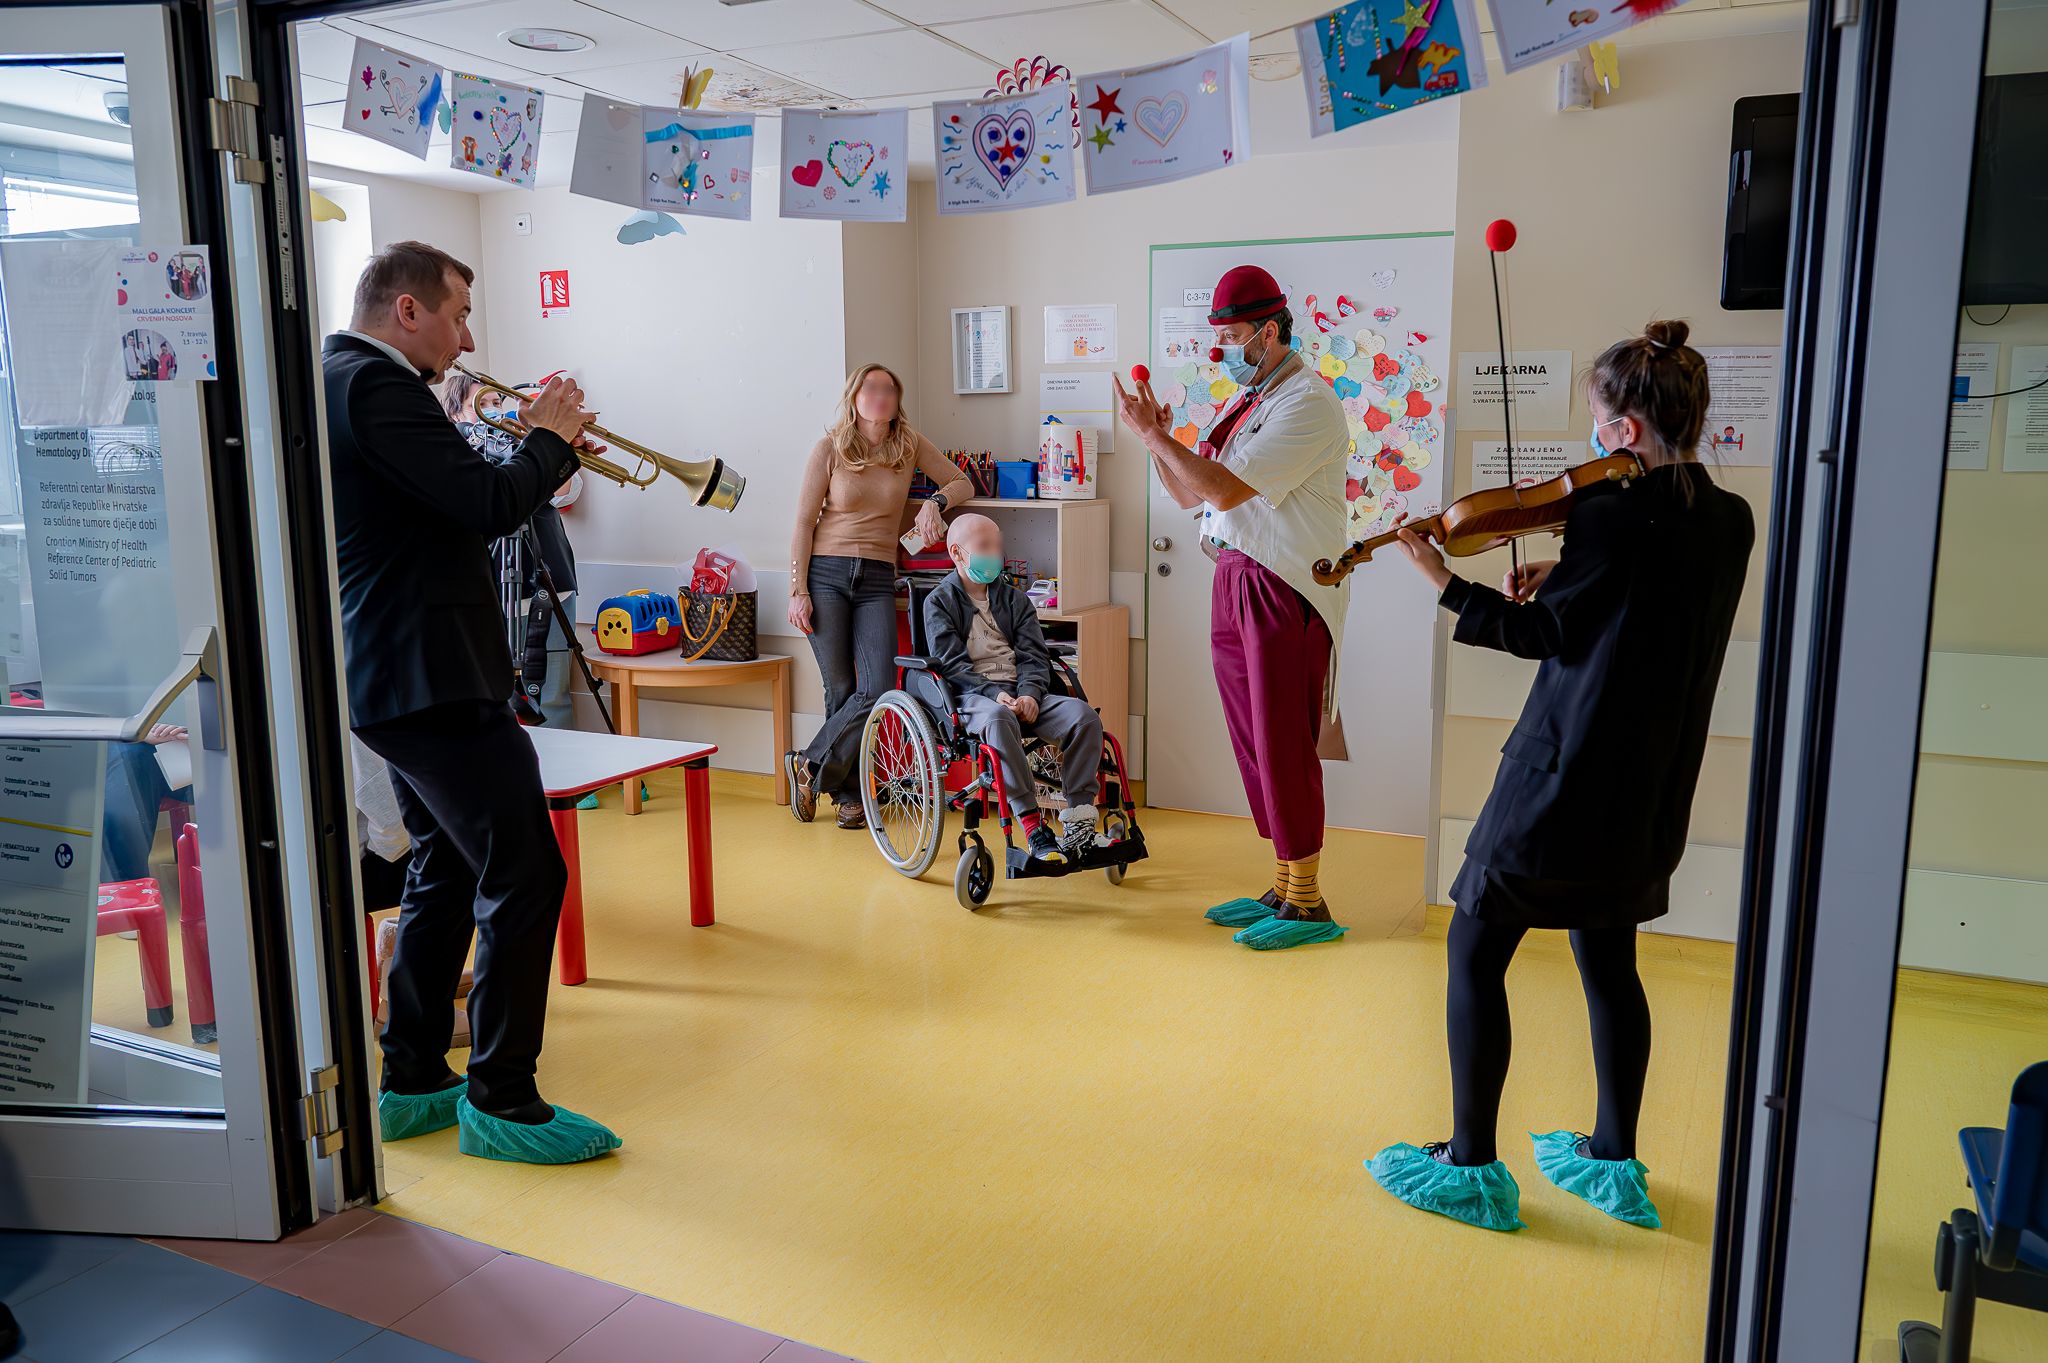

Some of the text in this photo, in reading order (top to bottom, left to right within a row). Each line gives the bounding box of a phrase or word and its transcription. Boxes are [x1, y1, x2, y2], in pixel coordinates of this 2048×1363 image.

[1186, 292, 1210, 301] C-3-79
[1475, 364, 1547, 375] LJEKARNA
[80, 430, 89, 442] of
[36, 447, 80, 459] Hematology
[40, 482, 156, 495] Referentni centar Ministarstva
[41, 499, 148, 512] zdravlja Republike Hrvatske
[43, 515, 157, 532] za solidne tumore dječje dobi
[45, 536, 147, 551] Croatian Ministry of Health
[48, 553, 157, 568] Reference Center of Pediatric
[49, 569, 97, 582] Solid Tumors
[4, 788, 27, 798] Operating
